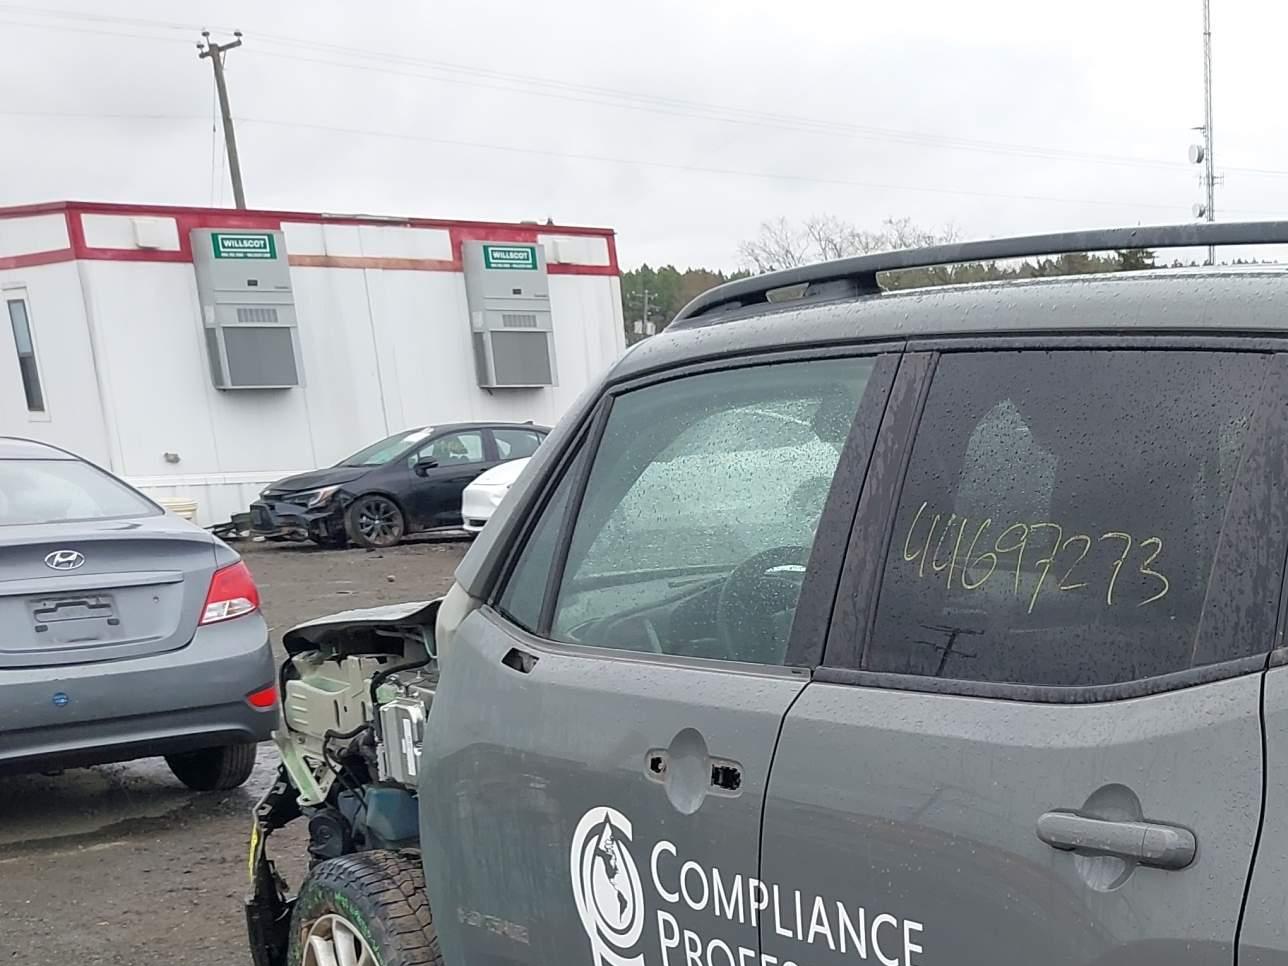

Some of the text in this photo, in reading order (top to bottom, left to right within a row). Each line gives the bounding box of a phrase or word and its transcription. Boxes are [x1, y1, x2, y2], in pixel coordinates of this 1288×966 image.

[222, 239, 265, 248] WILLSCOT
[492, 251, 528, 260] WILLSCOT
[903, 501, 1169, 614] 44697273
